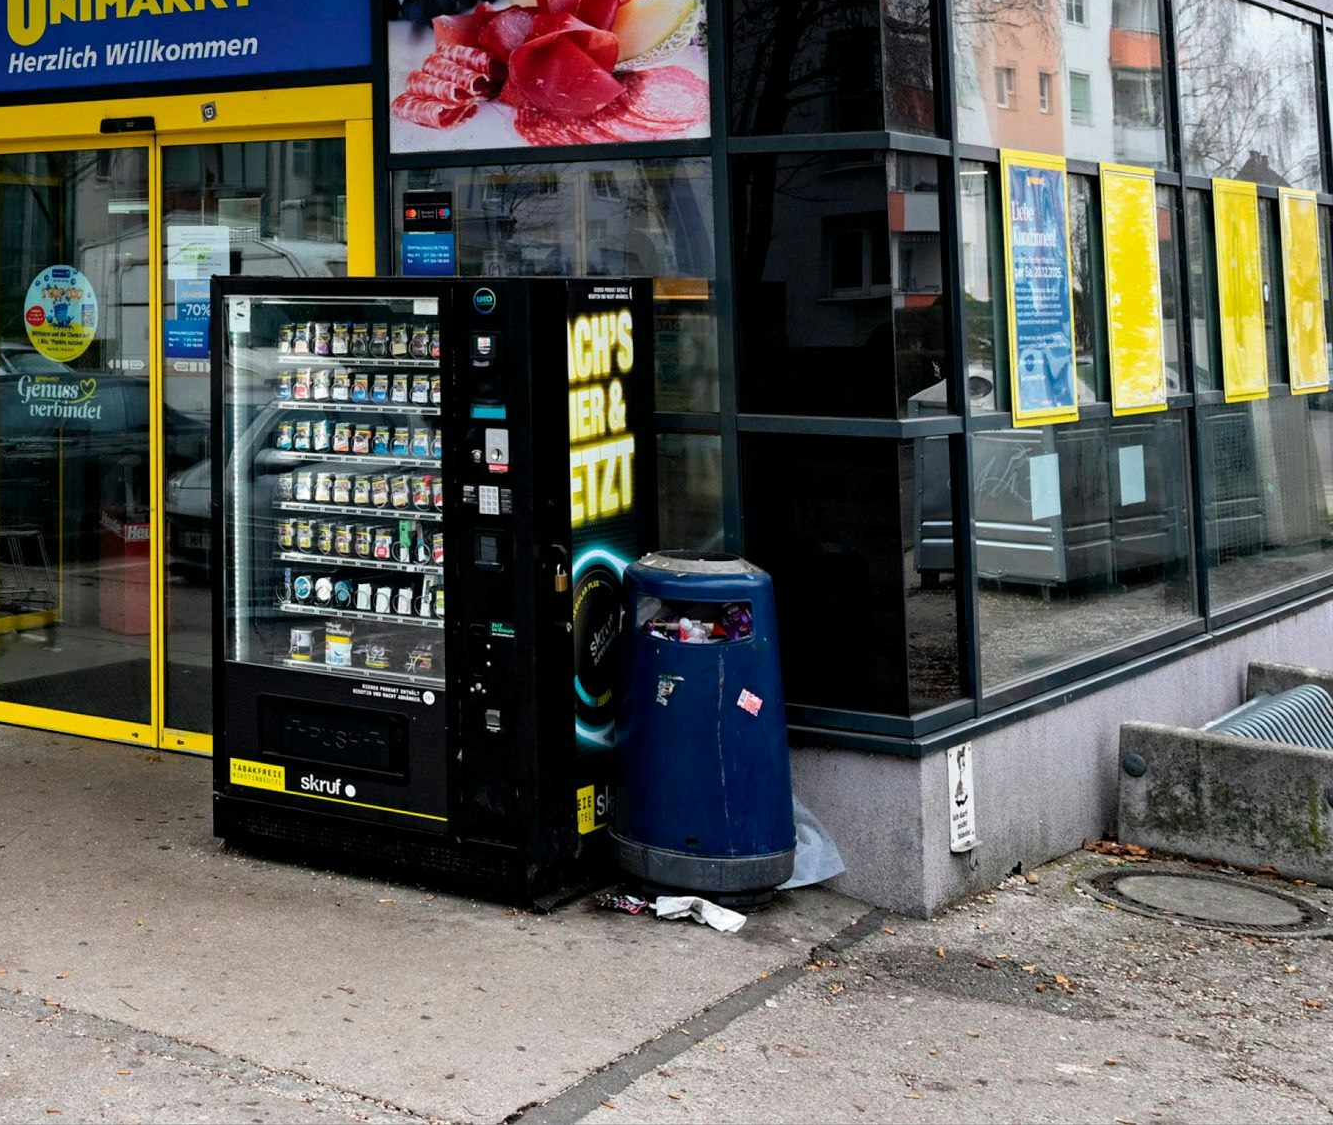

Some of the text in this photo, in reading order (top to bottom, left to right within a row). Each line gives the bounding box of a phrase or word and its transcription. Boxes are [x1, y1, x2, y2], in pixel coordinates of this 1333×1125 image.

[8, 37, 258, 73] Herzlich Willkommen
[18, 375, 79, 403] Genuss
[30, 400, 102, 419] verbindet
[609, 380, 626, 432] &
[373, 690, 382, 698] UND
[379, 685, 400, 695] PRODUKT
[400, 687, 420, 697] ENTHÄLT
[232, 763, 283, 779] TABAKFREIE
[300, 774, 342, 796] skruf
